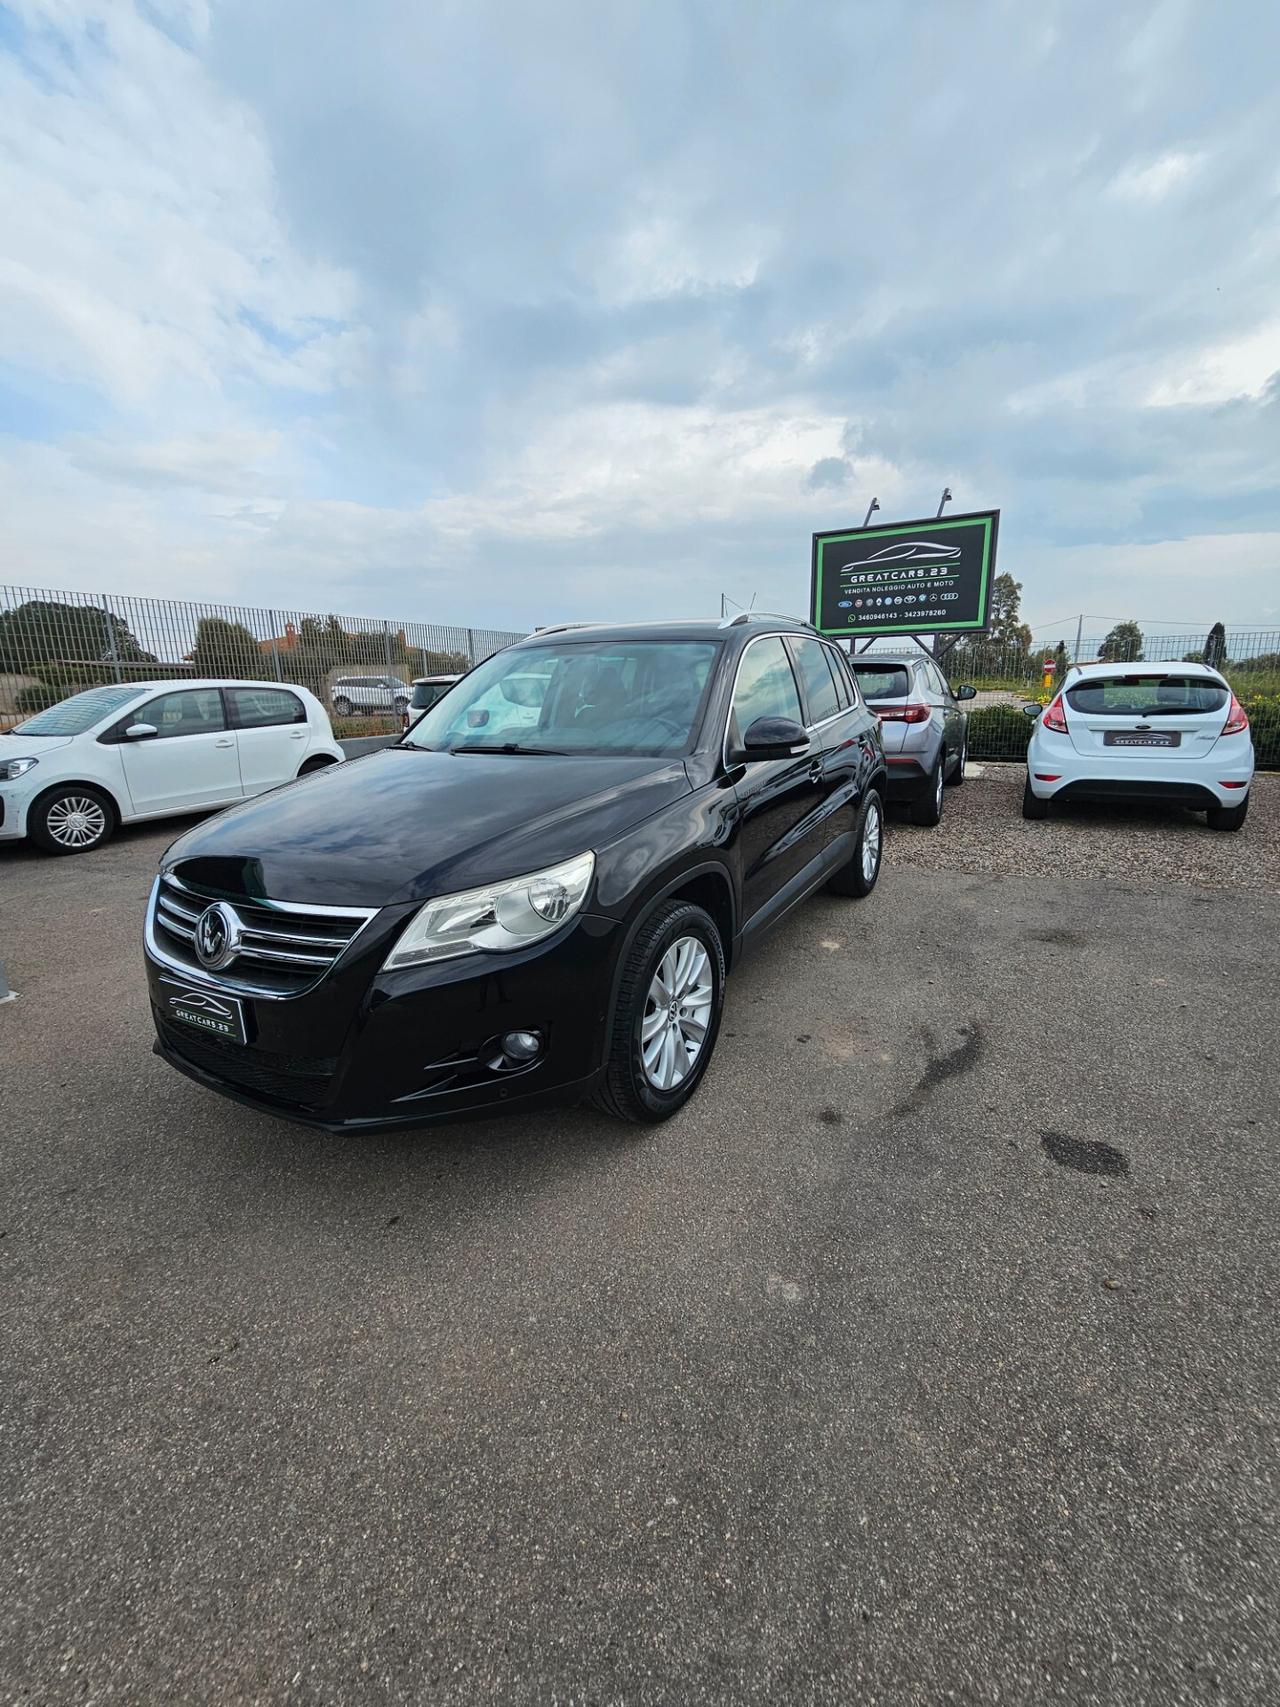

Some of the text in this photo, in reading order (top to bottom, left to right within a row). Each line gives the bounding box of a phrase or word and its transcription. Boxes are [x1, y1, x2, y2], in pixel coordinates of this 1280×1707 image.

[850, 567, 948, 583] GREATCARS.23
[844, 587, 870, 595] VENDITA
[872, 584, 906, 592] NOLEGGIO
[175, 1009, 229, 1033] GREATCARS.23
